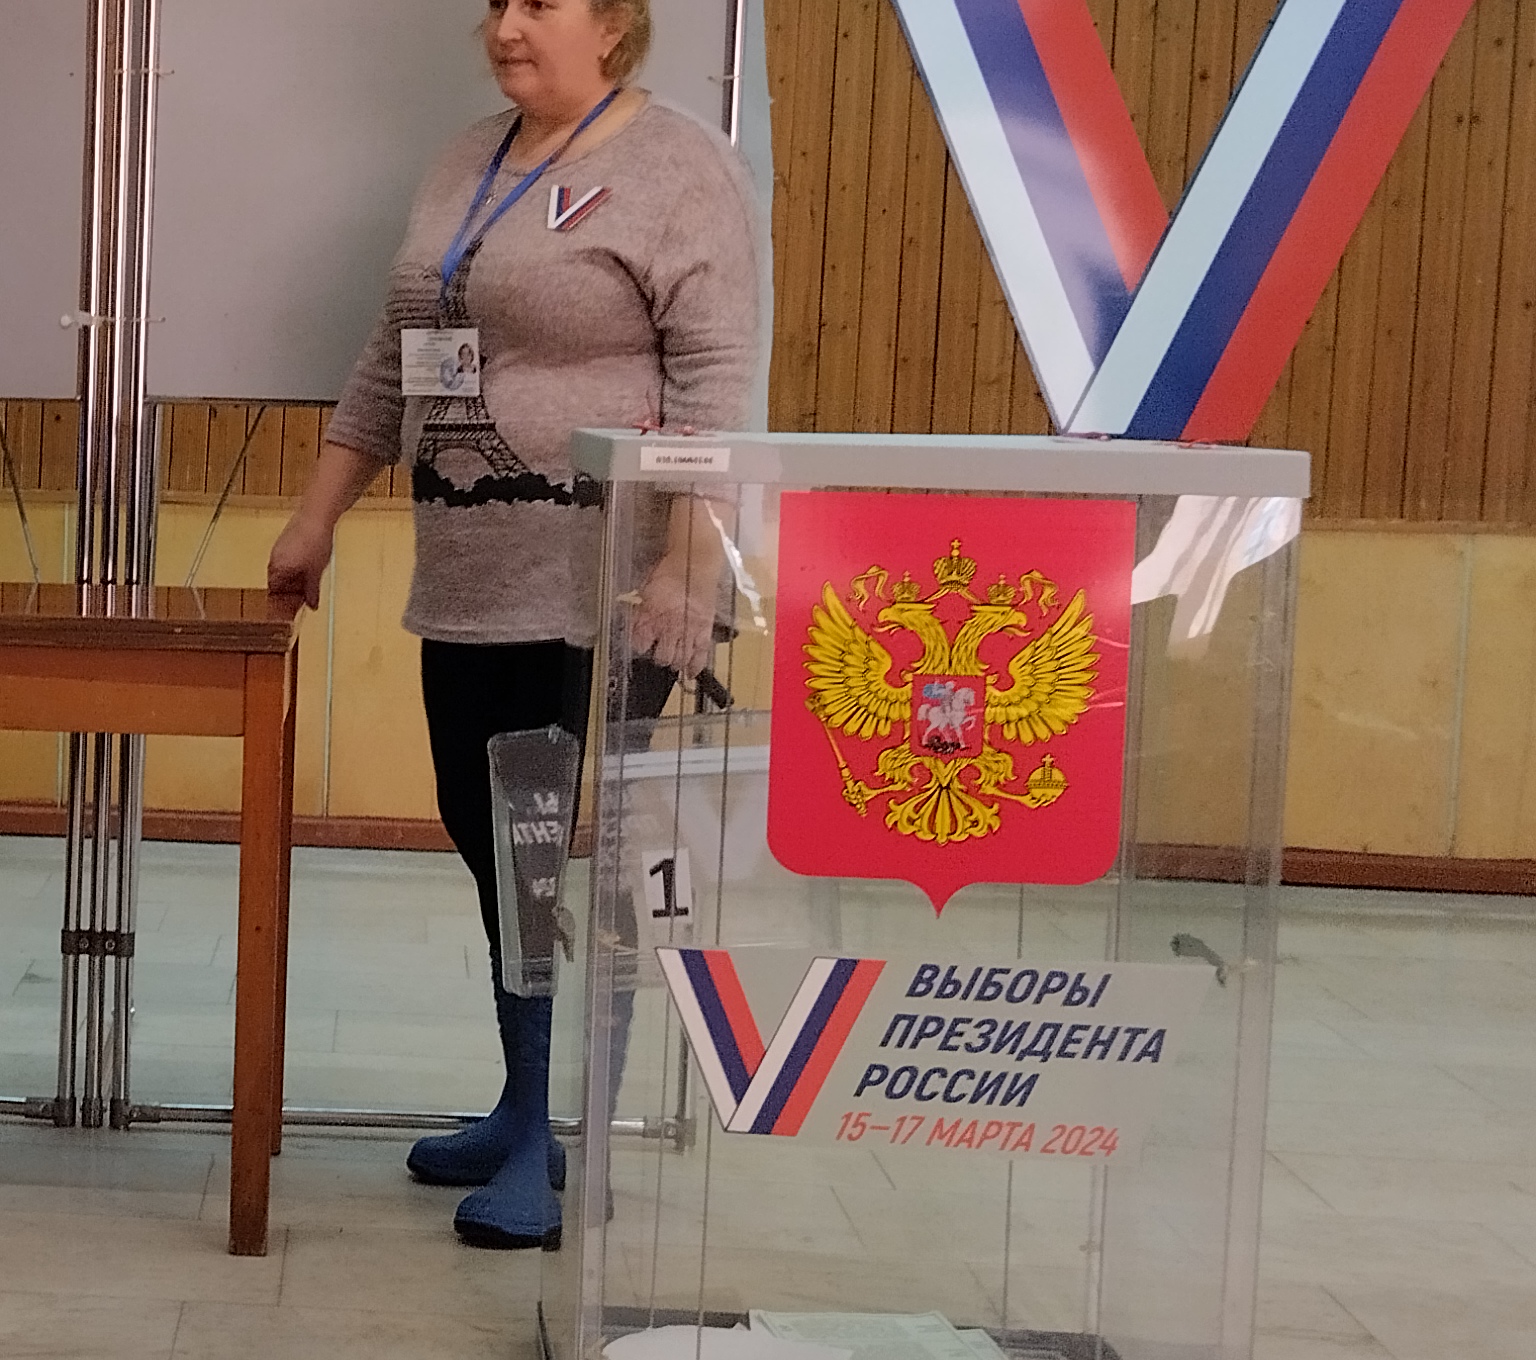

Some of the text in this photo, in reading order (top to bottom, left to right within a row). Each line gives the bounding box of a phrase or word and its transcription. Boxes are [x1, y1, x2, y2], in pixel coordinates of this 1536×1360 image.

[649, 857, 689, 918] 1
[905, 963, 1113, 1008] ВЫБОРЫ
[879, 1013, 1167, 1063] ПРЕЗИДЕНТА
[853, 1063, 1041, 1107] РОССИИ
[925, 1117, 1037, 1153] МАРТА
[1040, 1124, 1121, 1157] 2024
